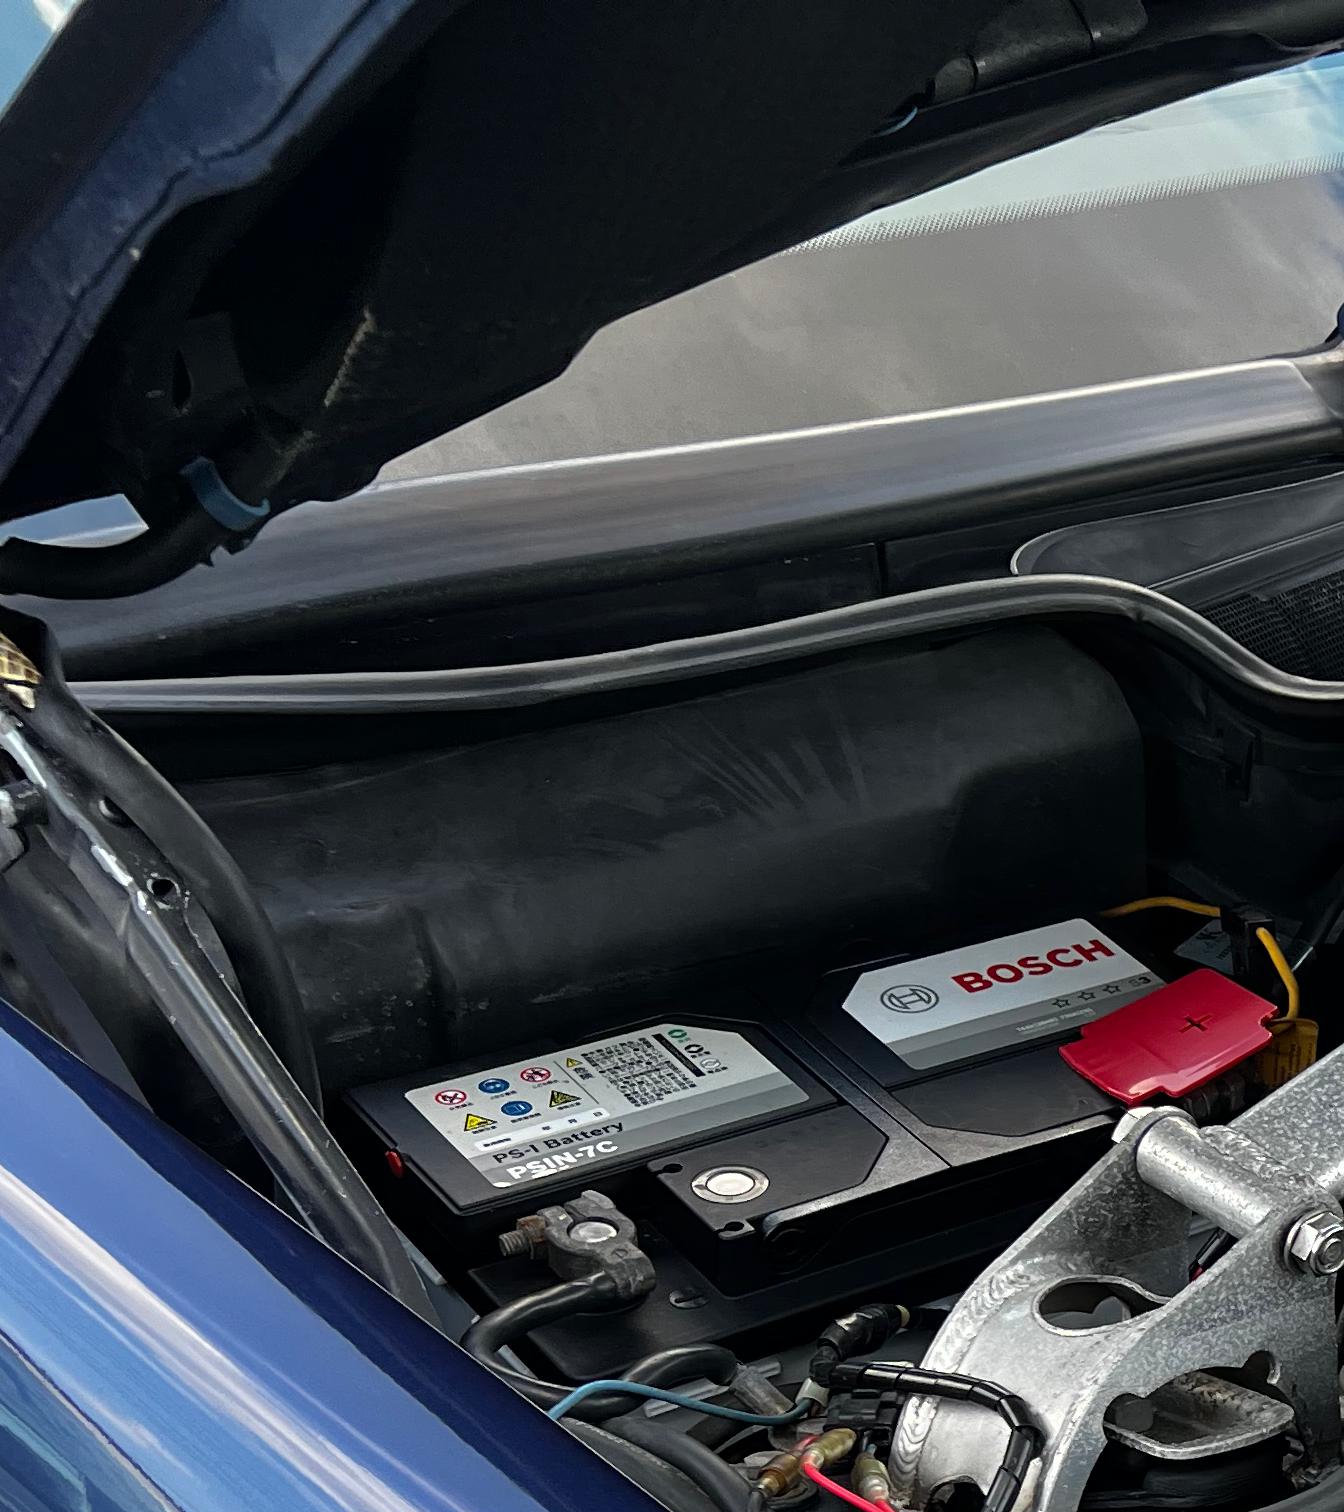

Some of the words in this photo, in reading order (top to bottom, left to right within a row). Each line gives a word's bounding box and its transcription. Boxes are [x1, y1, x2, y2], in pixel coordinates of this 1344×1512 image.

[951, 939, 1115, 993] BOSCH
[492, 1143, 540, 1164] PS-I
[543, 1121, 624, 1149] Battery
[506, 1140, 619, 1180] PSIN-7C
